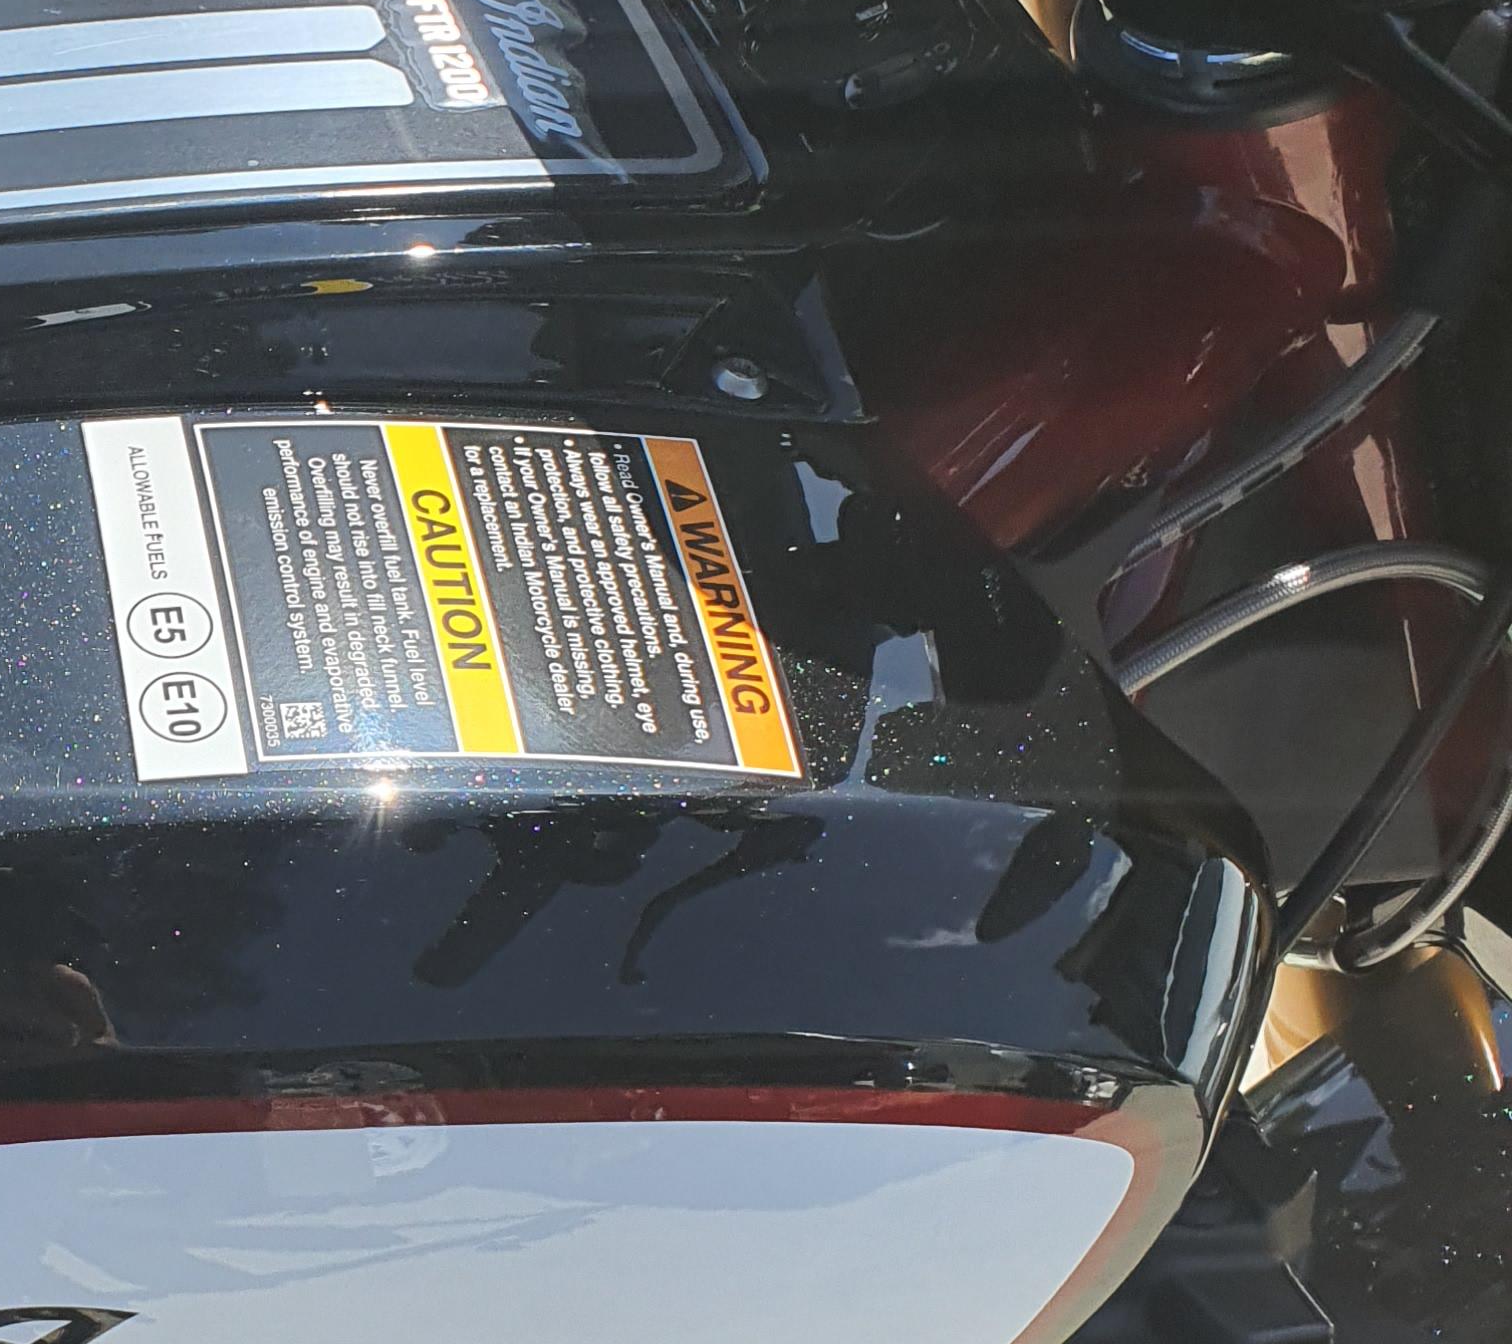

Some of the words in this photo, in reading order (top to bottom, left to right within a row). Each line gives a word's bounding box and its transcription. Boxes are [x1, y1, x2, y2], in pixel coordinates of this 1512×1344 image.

[429, 44, 490, 103] 1200
[464, 446, 482, 464] for
[469, 467, 484, 476] a
[488, 446, 519, 498] contact
[513, 447, 532, 456] If
[513, 459, 538, 490] your
[563, 449, 589, 497] Always
[588, 452, 611, 493] follow
[613, 454, 639, 488] Read
[273, 439, 309, 527] performance
[308, 457, 336, 527] Overfilling
[332, 453, 359, 499] should
[359, 460, 382, 501] Never
[534, 449, 571, 522] protection,
[128, 446, 159, 529] ALLOWABLE
[144, 533, 167, 580] FUELS
[262, 488, 289, 551] emission
[345, 504, 365, 527] not
[371, 504, 399, 550] overfill
[473, 479, 514, 572] replacement.
[505, 501, 522, 518] an
[528, 493, 558, 551] Owner's
[580, 501, 602, 536] wear
[602, 496, 623, 512] all
[626, 493, 656, 550] Owner's
[298, 531, 317, 545] of
[325, 531, 345, 561] may
[351, 531, 369, 557] rise
[511, 523, 536, 567] Indian
[562, 527, 586, 554] and
[592, 539, 607, 557] an
[608, 516, 633, 560] safety
[278, 555, 305, 608] control
[302, 549, 326, 599] engine
[333, 566, 357, 608] result
[359, 561, 378, 589] into
[383, 555, 407, 582] fuel
[411, 489, 492, 671] CAUTION
[545, 556, 577, 610] Manual
[644, 555, 678, 610] Manual
[314, 604, 338, 632] and
[344, 613, 361, 626] in
[366, 594, 387, 611] fill
[391, 587, 414, 624] tank.
[524, 571, 562, 658] Motorcycle
[568, 558, 605, 635] protective
[596, 562, 635, 634] approved
[619, 563, 661, 658] precautions.
[680, 521, 771, 715] WARNING
[150, 607, 186, 644] E5
[287, 613, 313, 673] system.
[371, 616, 395, 653] neck
[561, 615, 580, 628] is
[663, 613, 688, 648] and,
[401, 630, 425, 662] Fuel
[567, 633, 595, 699] missing,
[620, 639, 650, 698] helmet,
[323, 638, 353, 733] evaporative
[347, 631, 380, 708] degraded
[380, 658, 408, 713] funnel.
[410, 669, 436, 705] level
[548, 663, 575, 715] dealer
[594, 640, 624, 709] clothing.
[674, 652, 701, 705] during
[162, 680, 201, 737] E10
[260, 695, 280, 747] 7300035
[635, 703, 657, 733] eye
[690, 709, 710, 744] use,
